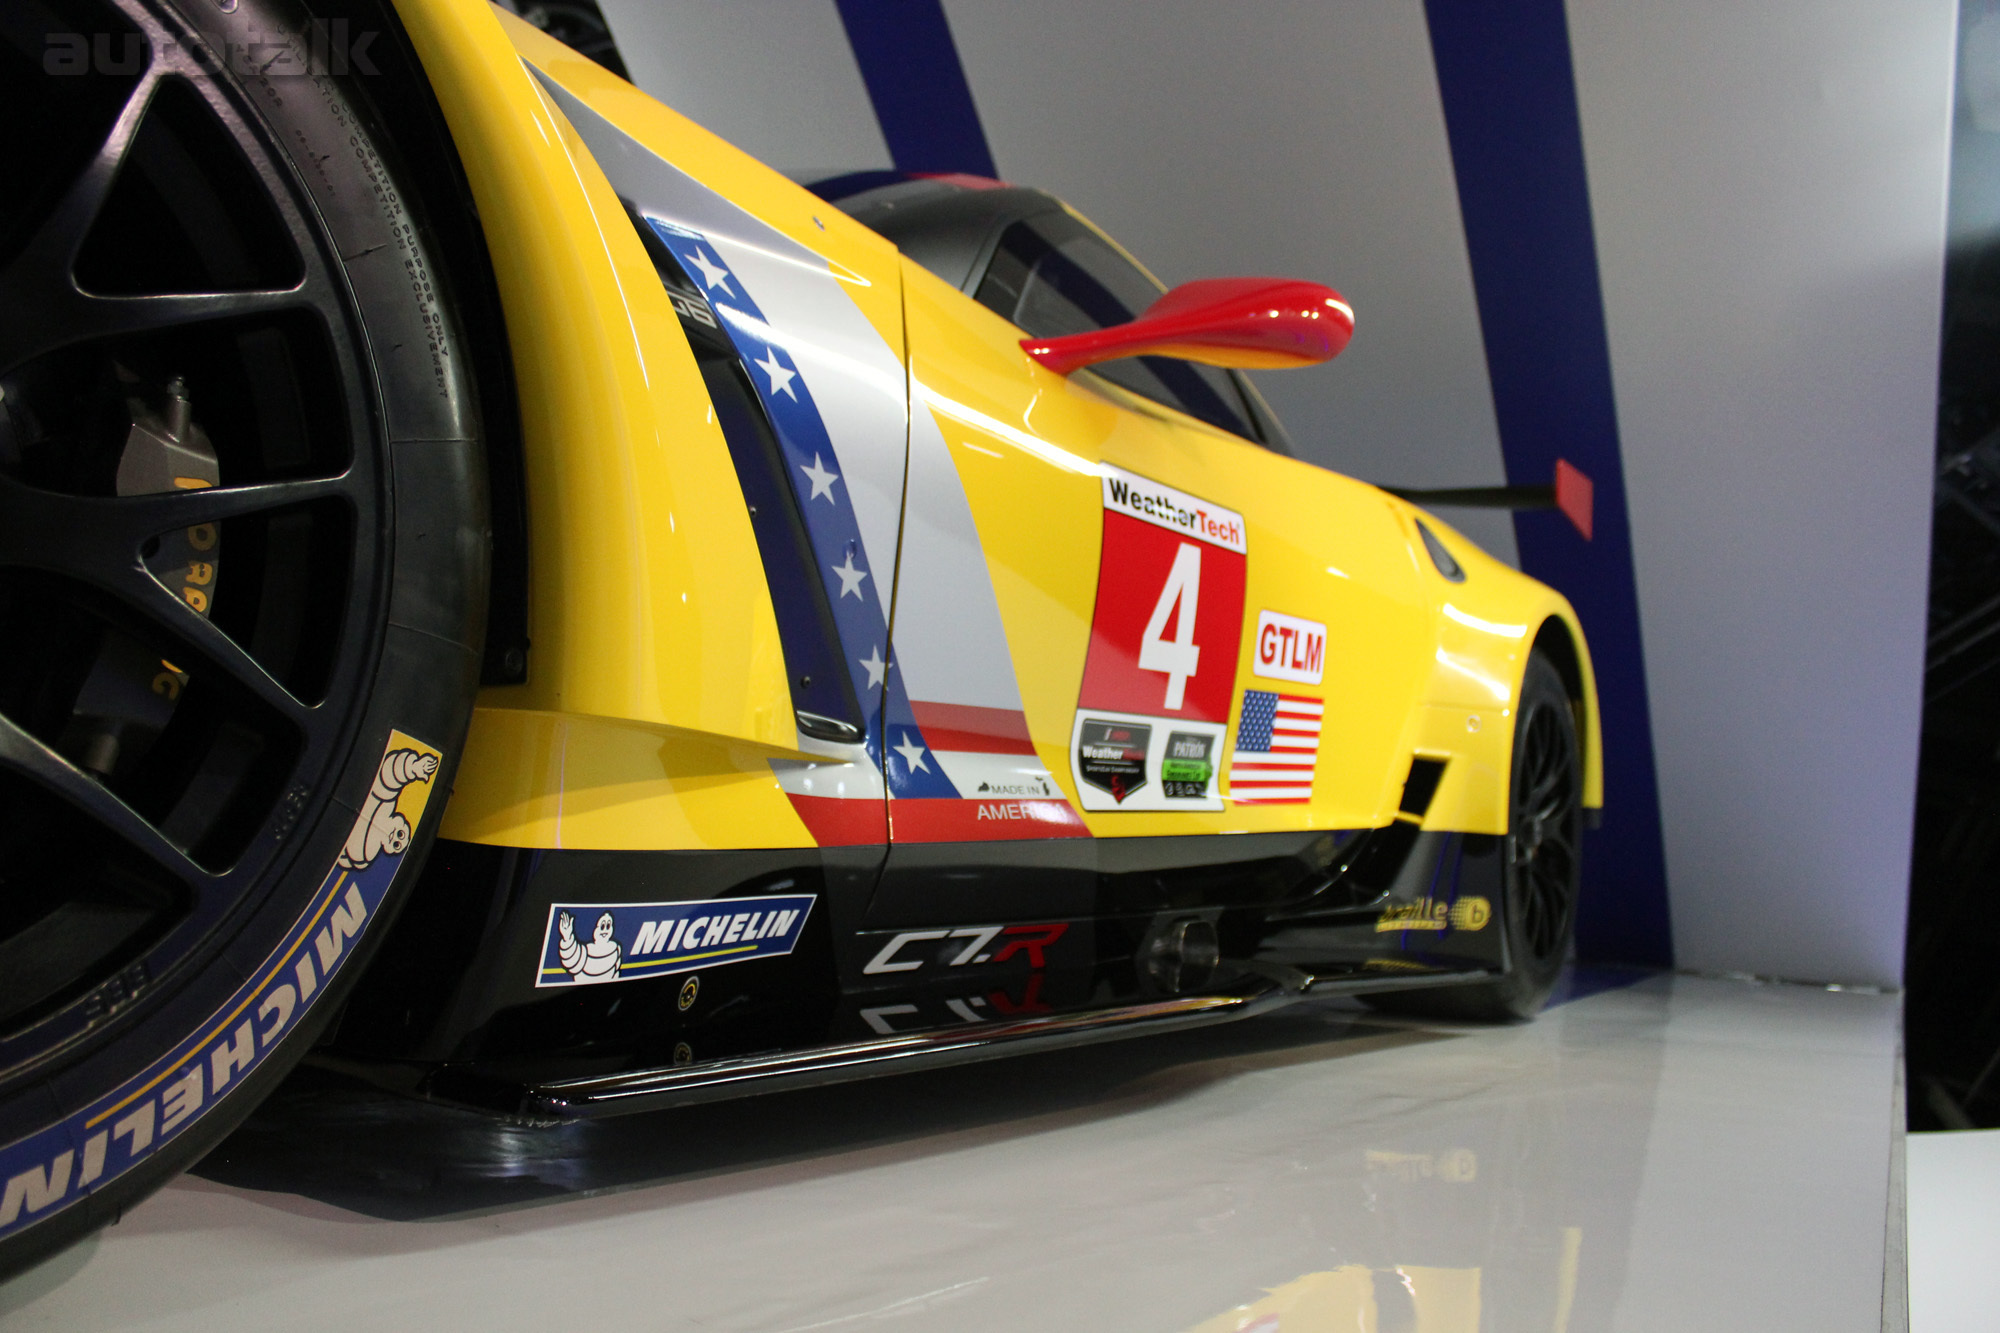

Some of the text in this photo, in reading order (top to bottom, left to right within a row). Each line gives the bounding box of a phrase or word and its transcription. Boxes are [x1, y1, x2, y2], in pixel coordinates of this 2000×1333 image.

[341, 102, 449, 357] COMPETITION PURPOSE ONLY
[350, 135, 407, 251] COMPETITION
[405, 258, 449, 399] EXCLUSIVEMENT
[1109, 477, 1240, 545] WeatherTech
[1138, 542, 1201, 711] 4
[1260, 623, 1323, 675] GTLM
[991, 785, 1040, 795] MADE IN
[630, 909, 800, 956] MICHELIN
[0, 882, 368, 1228] MICHELIN
